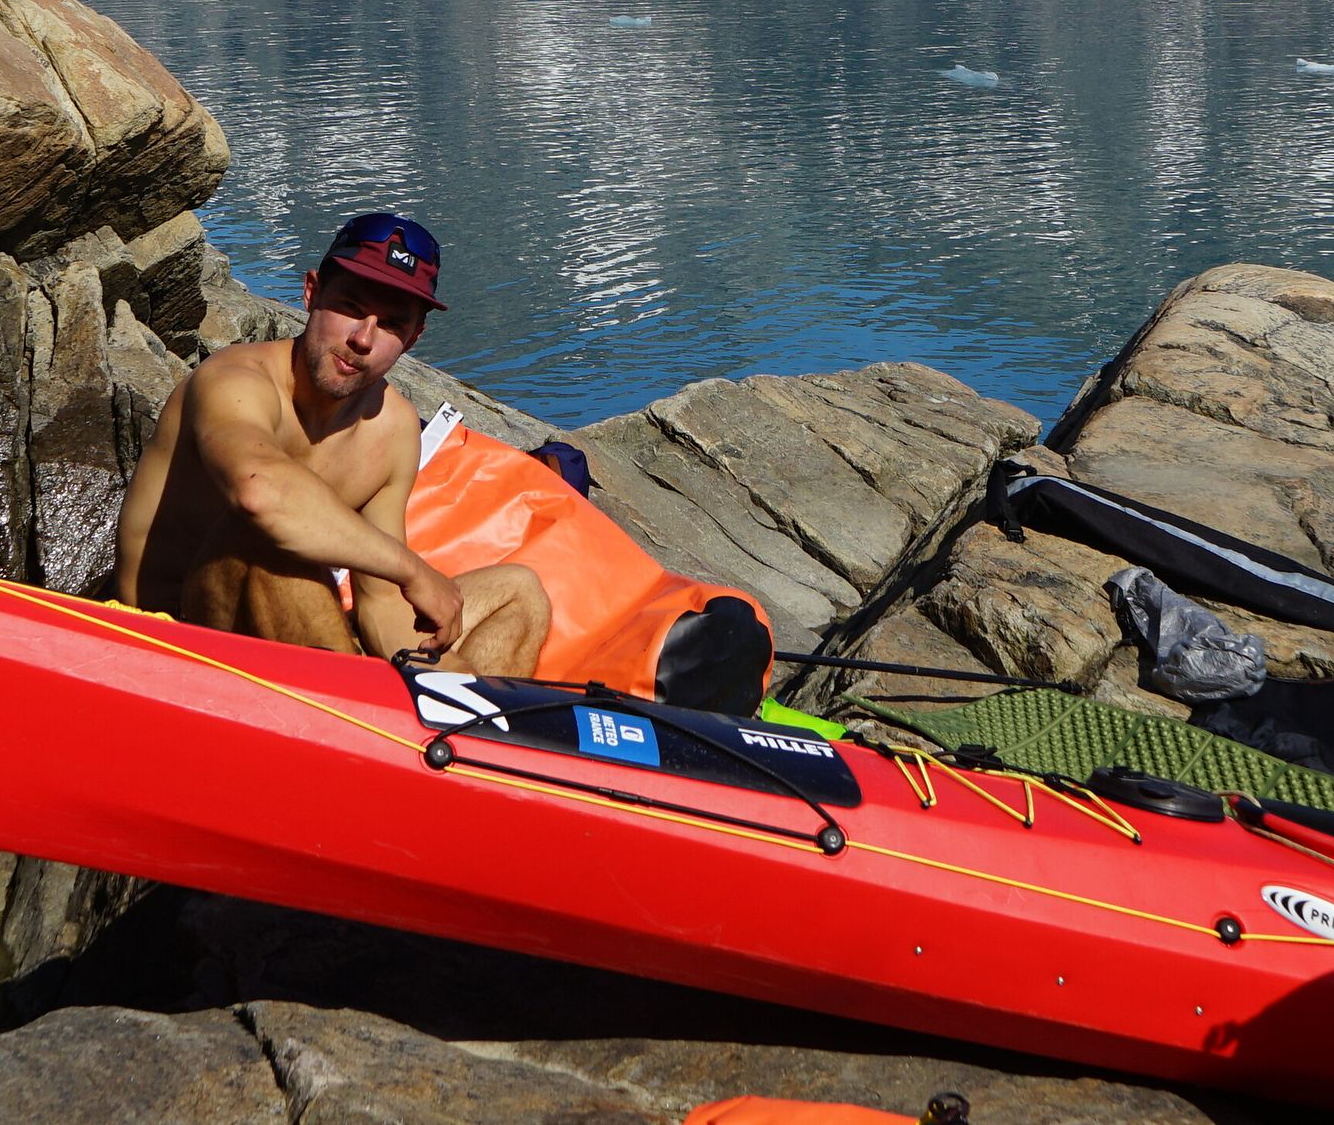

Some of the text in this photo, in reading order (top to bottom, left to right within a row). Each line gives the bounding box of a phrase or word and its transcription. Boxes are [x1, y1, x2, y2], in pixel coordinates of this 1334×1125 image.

[588, 712, 605, 744] FRANCE
[602, 714, 619, 747] METEO
[741, 732, 835, 758] MILLET
